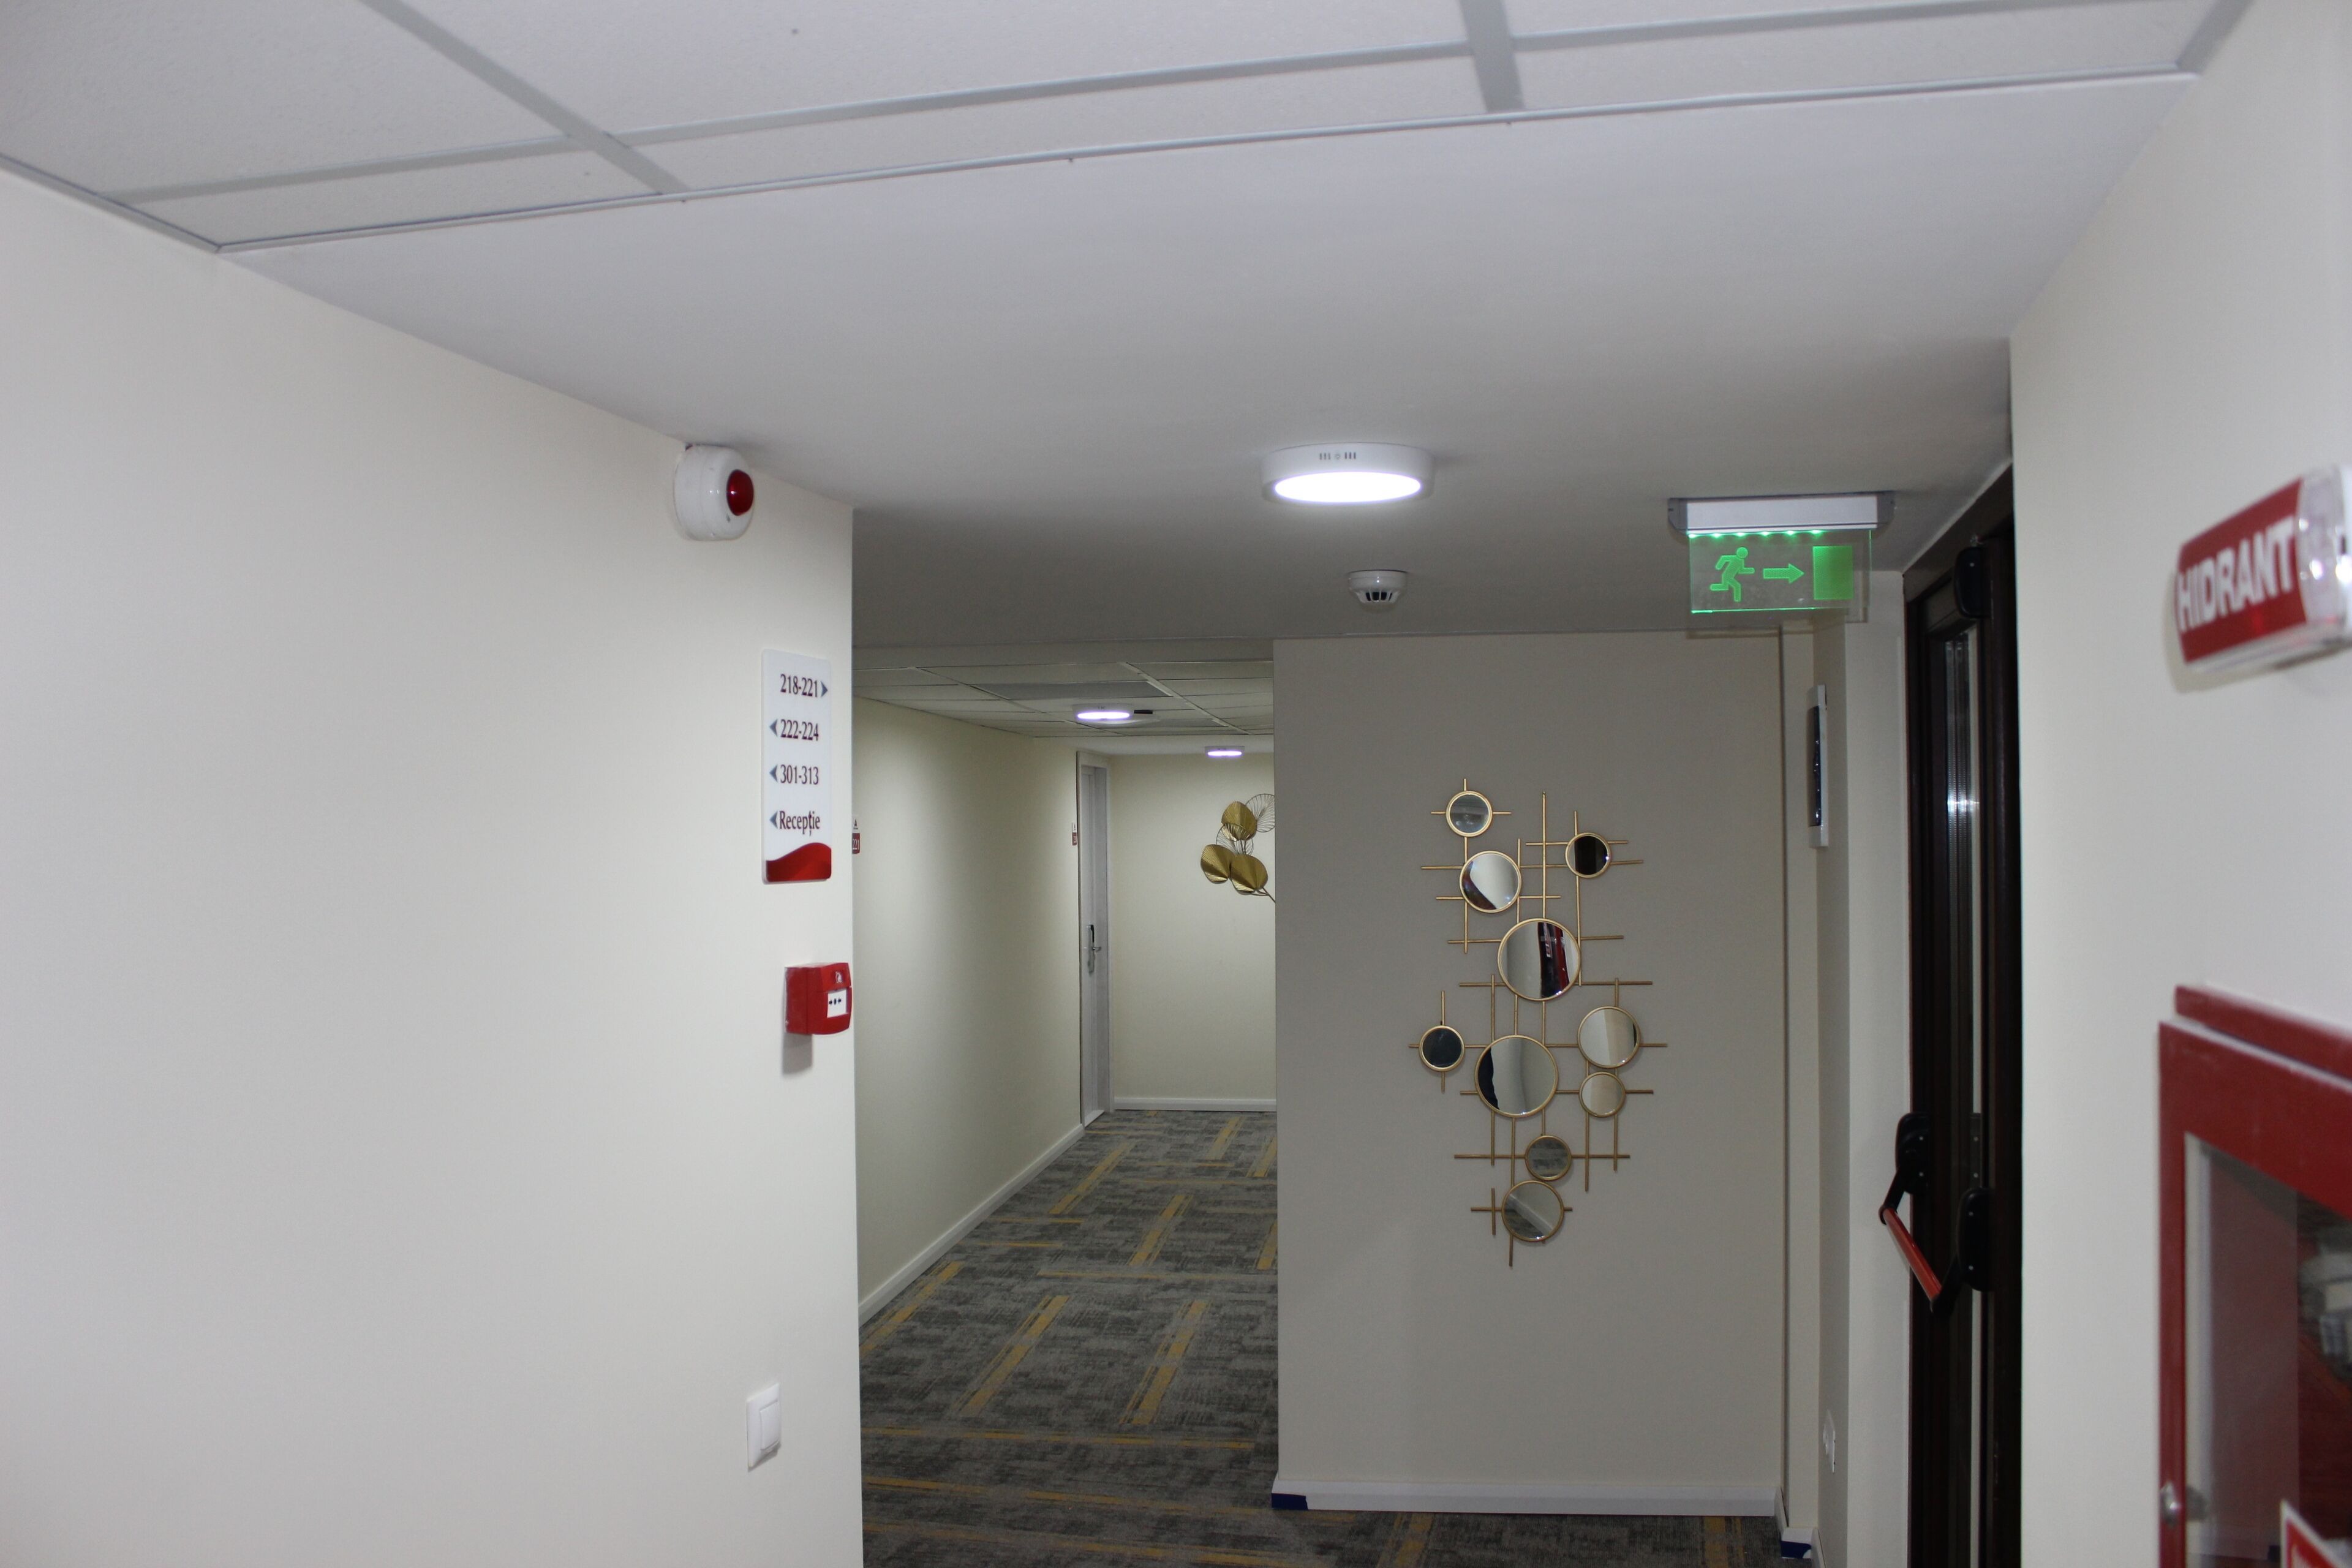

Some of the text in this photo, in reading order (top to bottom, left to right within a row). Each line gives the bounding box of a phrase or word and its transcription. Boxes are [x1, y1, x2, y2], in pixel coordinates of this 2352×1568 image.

[2177, 516, 2295, 633] HIDRANT
[780, 673, 818, 698] 218-221
[780, 718, 819, 741] 222-224
[780, 764, 819, 785] 301-313
[779, 810, 820, 837] Recepție
